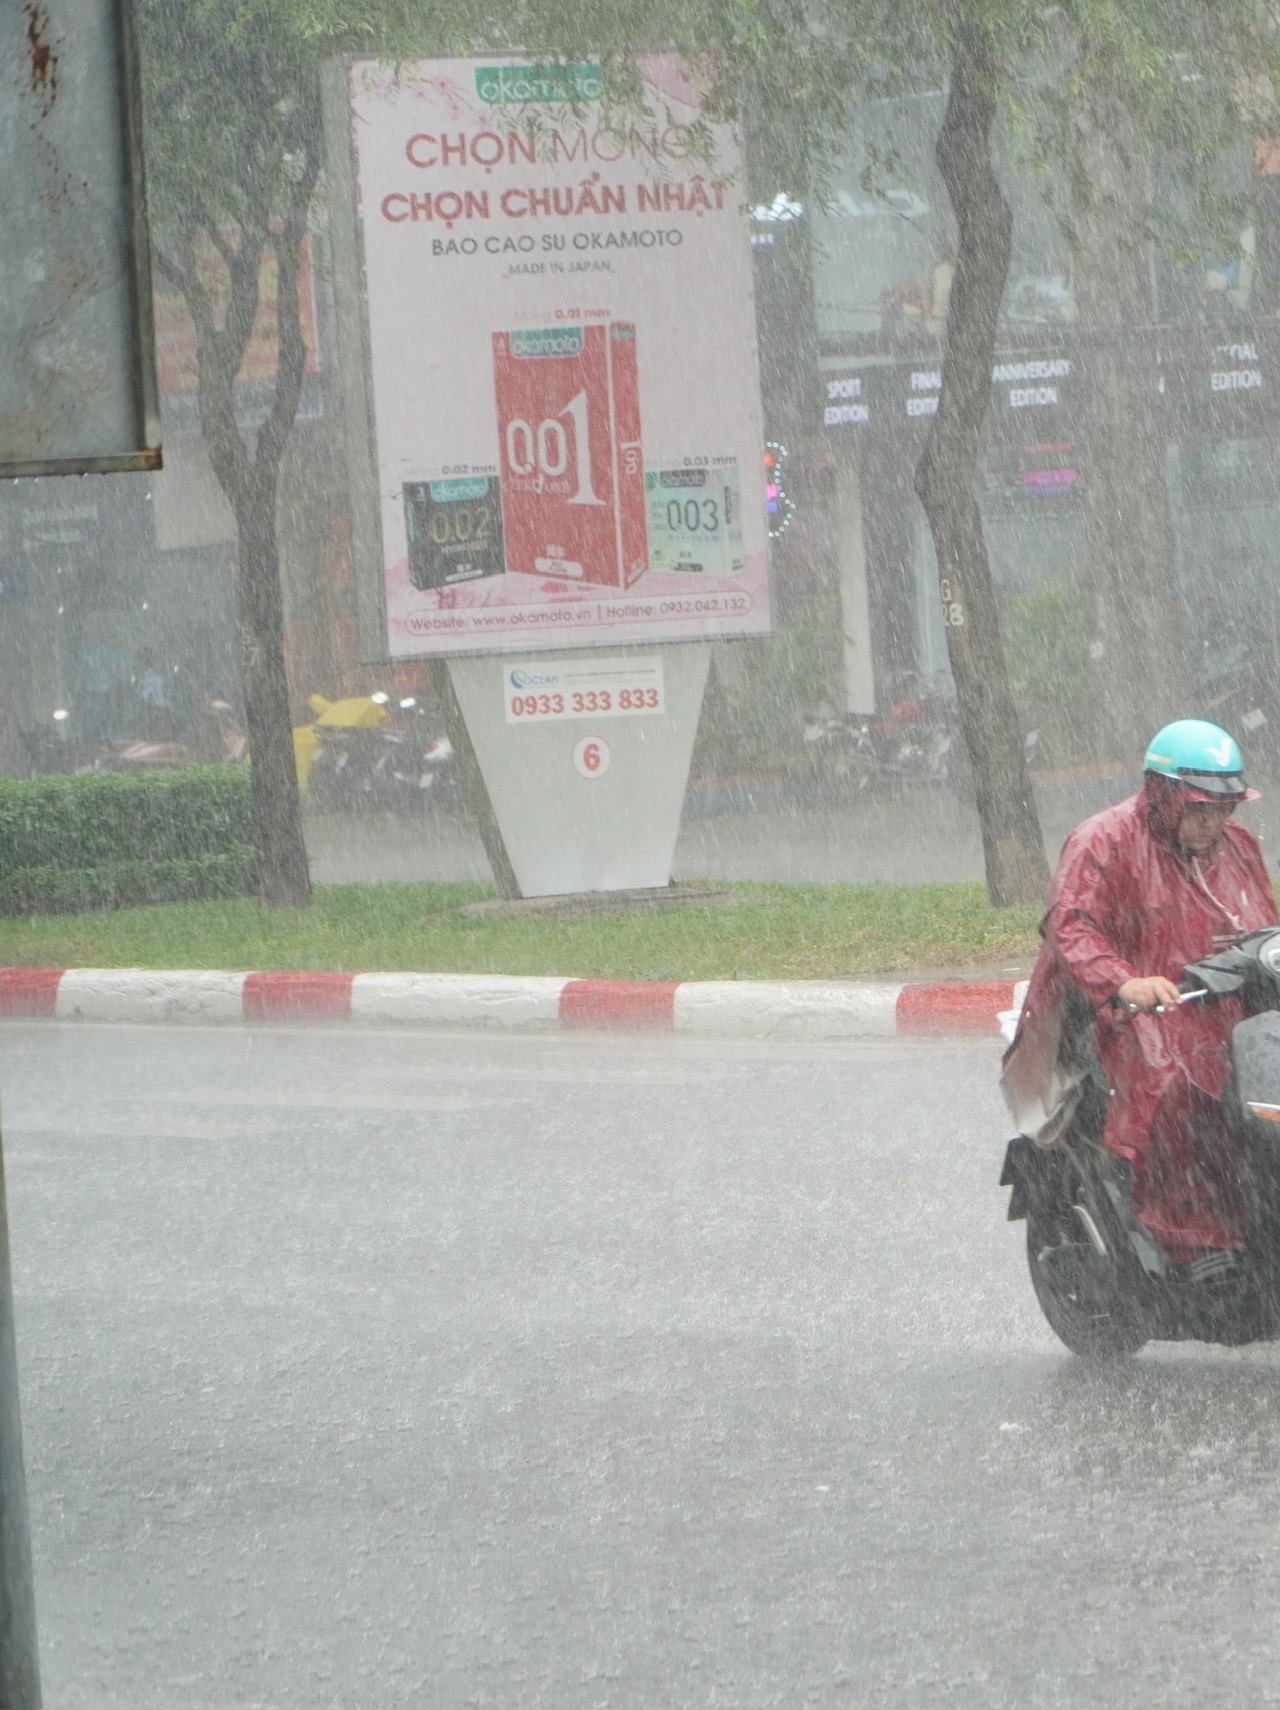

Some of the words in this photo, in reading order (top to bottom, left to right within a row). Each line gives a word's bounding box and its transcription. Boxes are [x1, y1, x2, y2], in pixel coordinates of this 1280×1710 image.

[405, 130, 537, 174] CHỌN
[381, 191, 490, 229] CHỌN
[501, 171, 626, 218] CHUẨN
[637, 174, 726, 217] NHẬT
[432, 238, 478, 256] BAO
[485, 234, 535, 254] CAO
[541, 233, 565, 251] SU
[573, 229, 683, 251] OKAMOTO
[549, 261, 564, 274] IN
[1209, 370, 1262, 391] EDITION
[1009, 387, 1058, 407] EDITION
[824, 405, 869, 426] EDITION
[410, 616, 469, 631] Website:
[472, 609, 592, 627] www.okamoto.vn
[606, 605, 657, 619] Hotline:
[659, 597, 746, 615] 0932.042.132
[511, 694, 565, 717] 0933
[571, 690, 613, 713] 333
[618, 687, 660, 710] 833
[582, 742, 602, 772] 6
